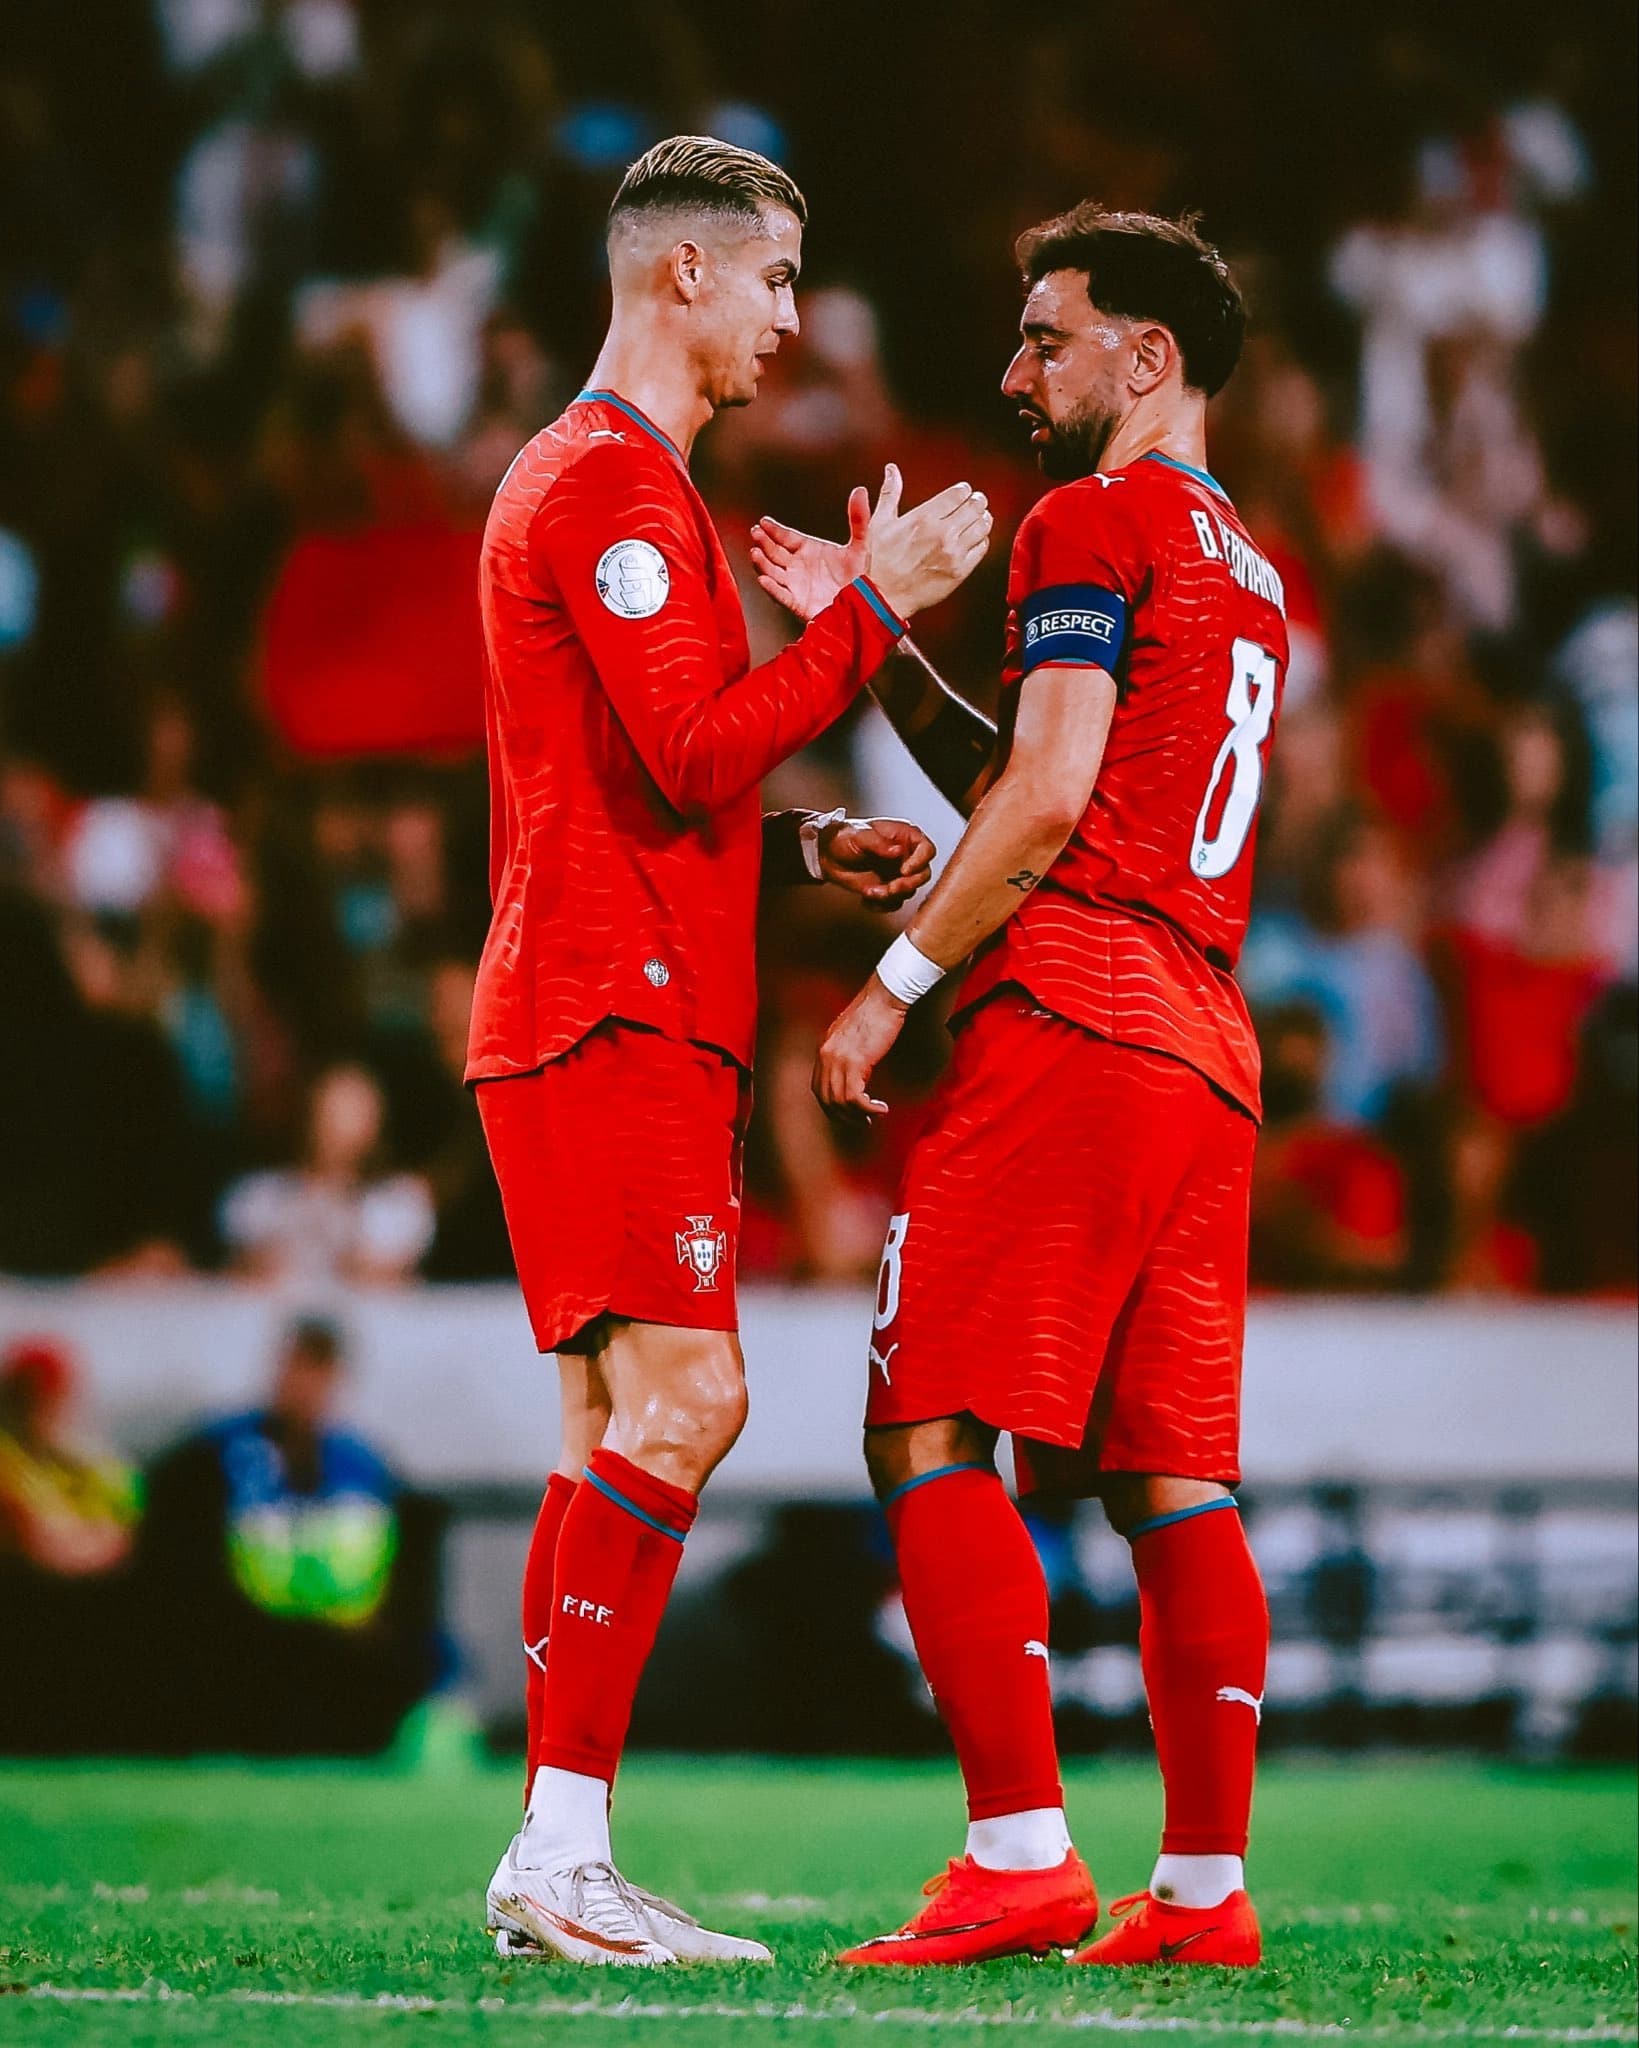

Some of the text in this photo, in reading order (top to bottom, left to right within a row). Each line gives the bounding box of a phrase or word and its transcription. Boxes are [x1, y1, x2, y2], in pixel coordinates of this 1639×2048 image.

[1041, 614, 1114, 637] RESPECT
[1190, 636, 1277, 879] 8
[874, 1212, 911, 1331] 8
